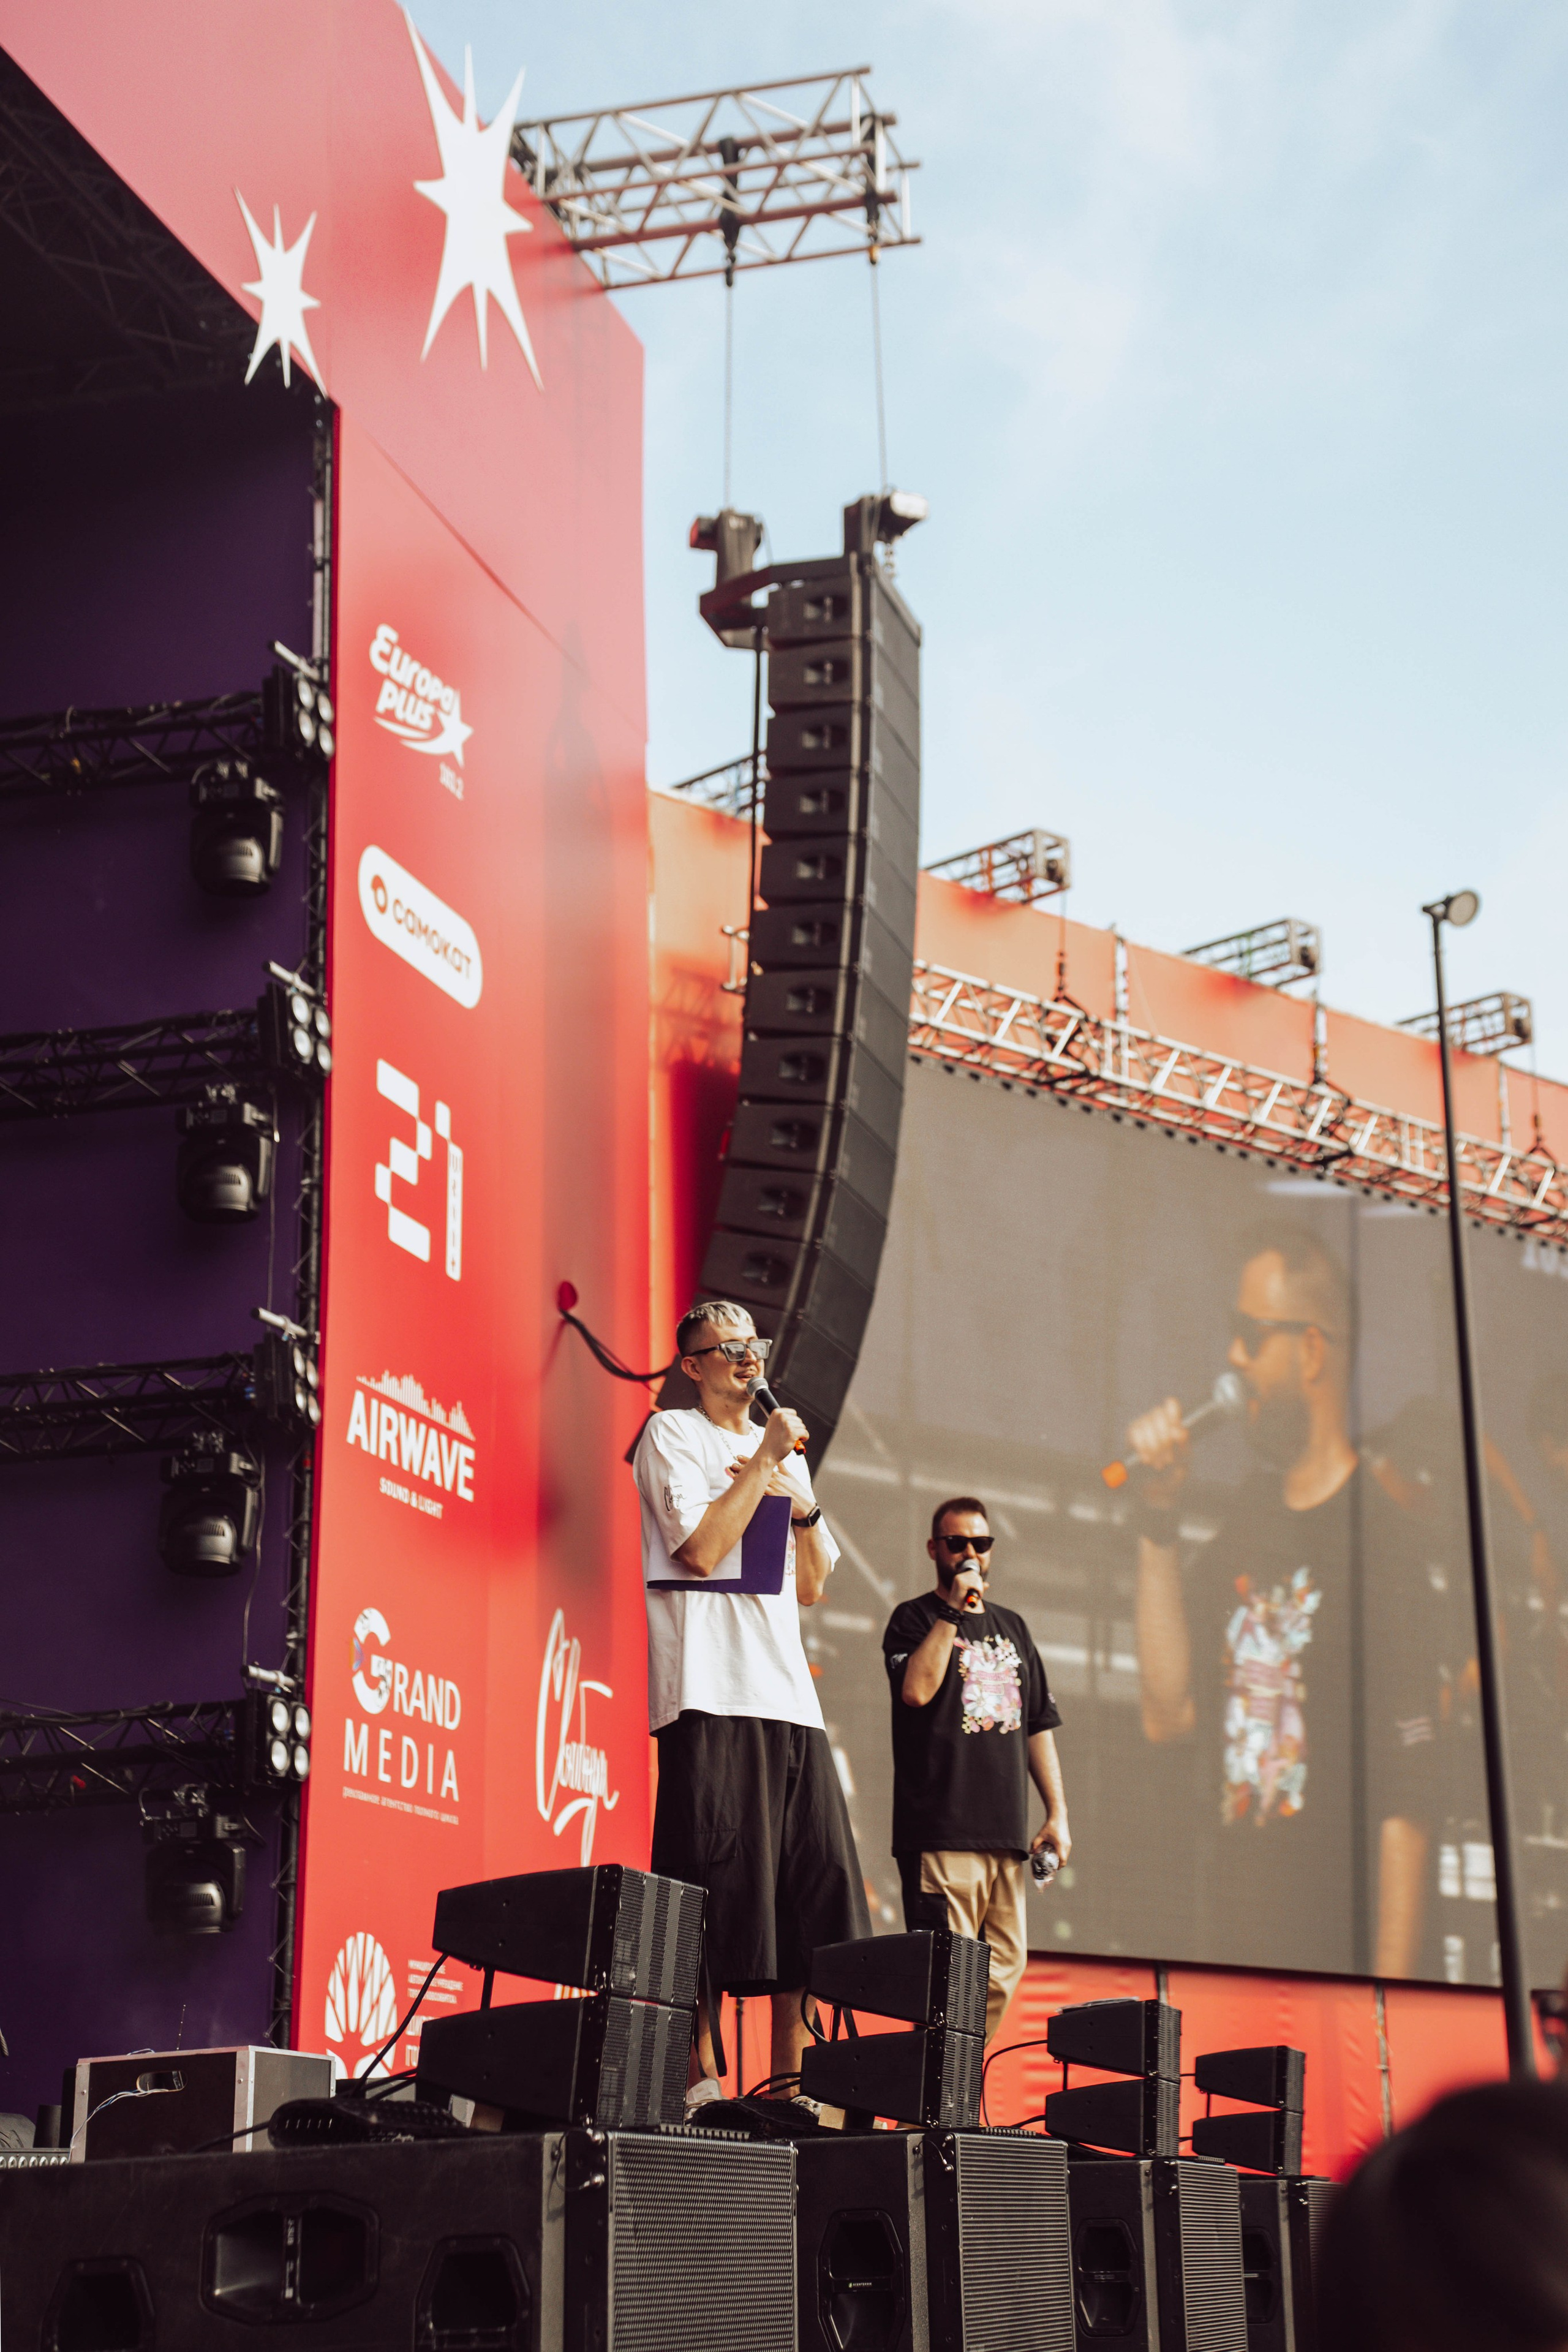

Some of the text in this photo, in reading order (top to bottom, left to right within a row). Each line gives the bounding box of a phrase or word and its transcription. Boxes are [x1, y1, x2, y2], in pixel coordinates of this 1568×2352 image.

[346, 1389, 475, 1503] AIRWAVE
[379, 1476, 409, 1504] SOUND
[418, 1494, 443, 1519] LIGHT
[349, 1607, 461, 1730] GRAND
[343, 1717, 459, 1803] MEDIA
